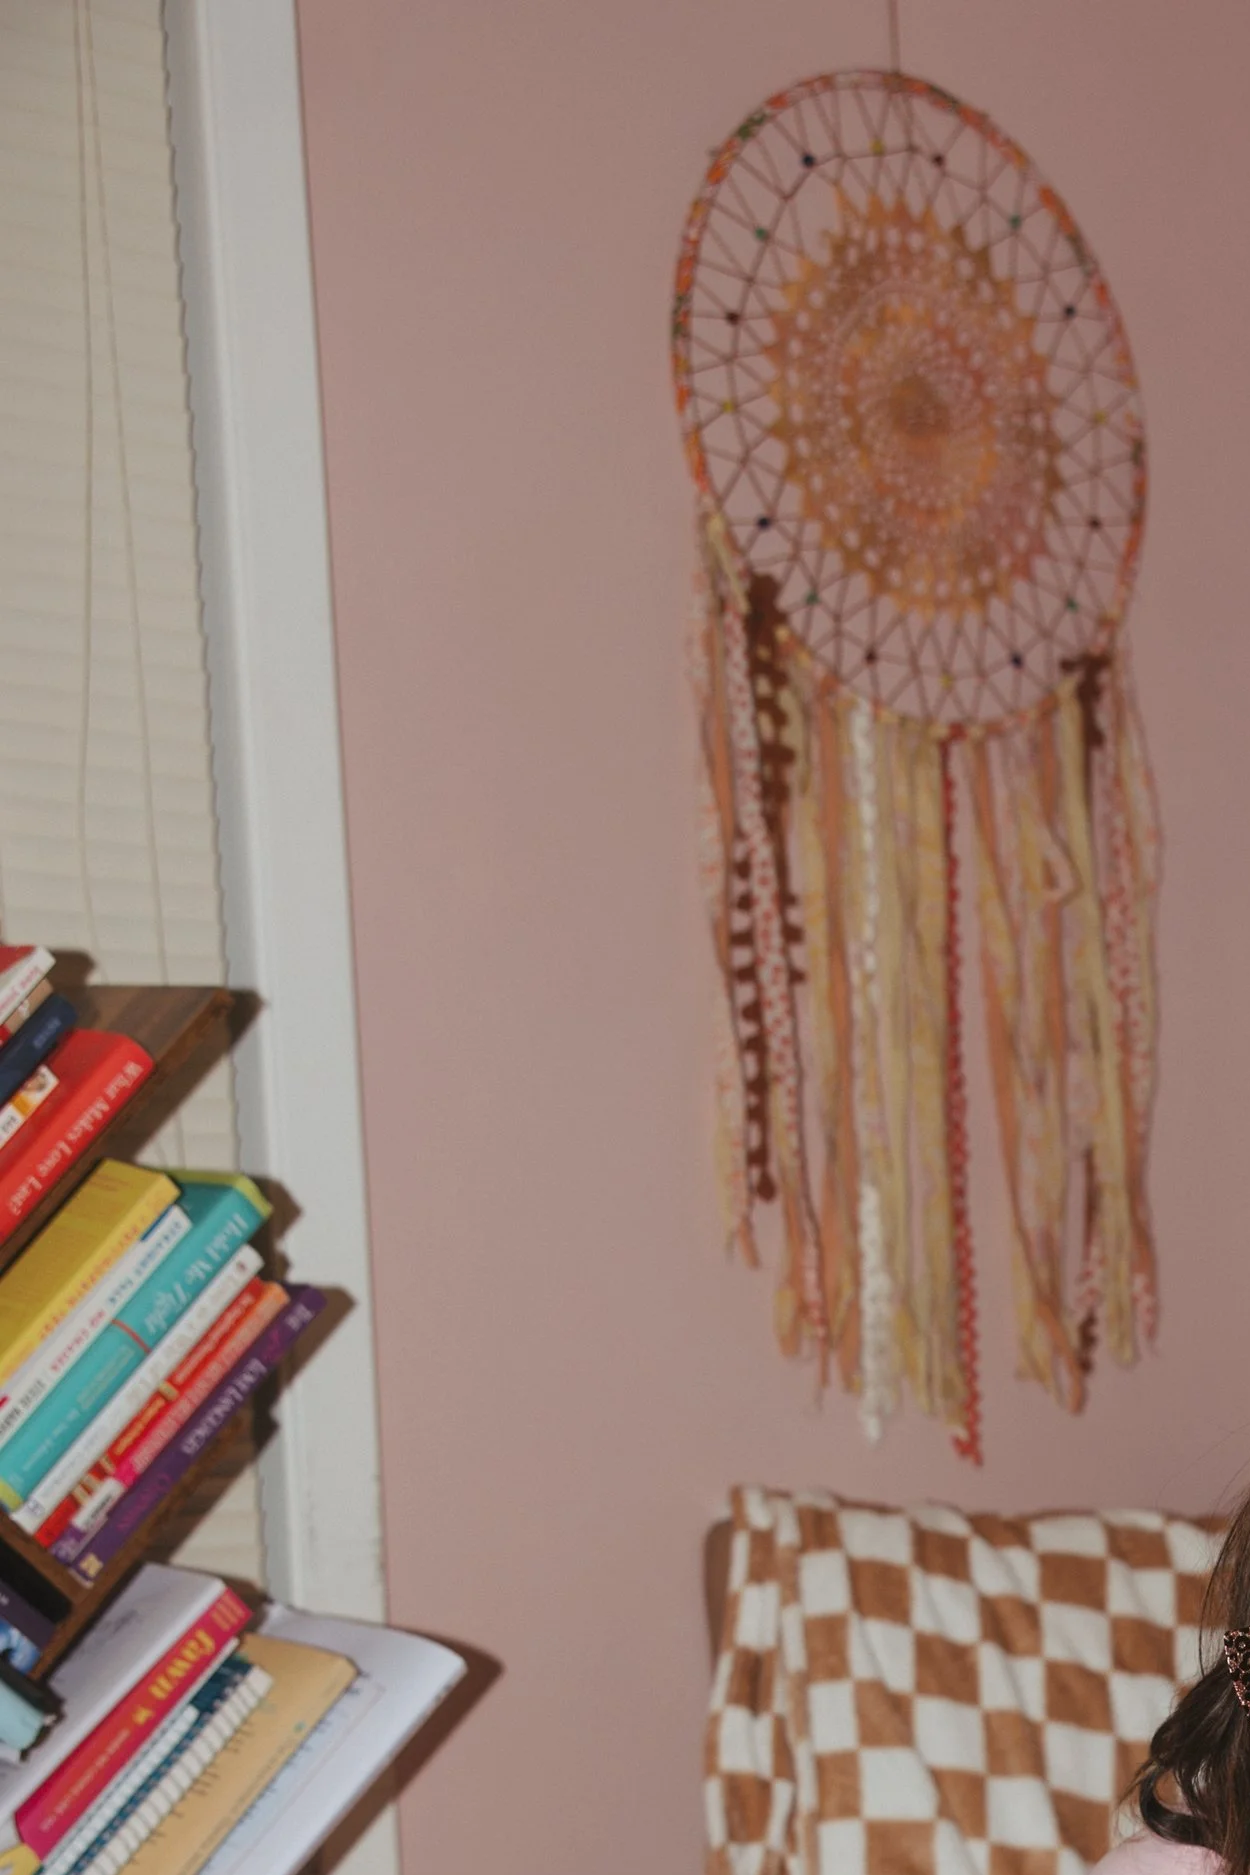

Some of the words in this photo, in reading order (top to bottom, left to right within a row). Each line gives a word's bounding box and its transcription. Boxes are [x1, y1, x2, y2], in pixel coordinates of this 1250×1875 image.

[102, 1058, 143, 1102] What
[64, 1094, 112, 1146] Makes
[33, 1138, 74, 1181] Love
[202, 1212, 250, 1263] Hold
[180, 1255, 214, 1289] Me
[146, 1628, 216, 1703] fawn
